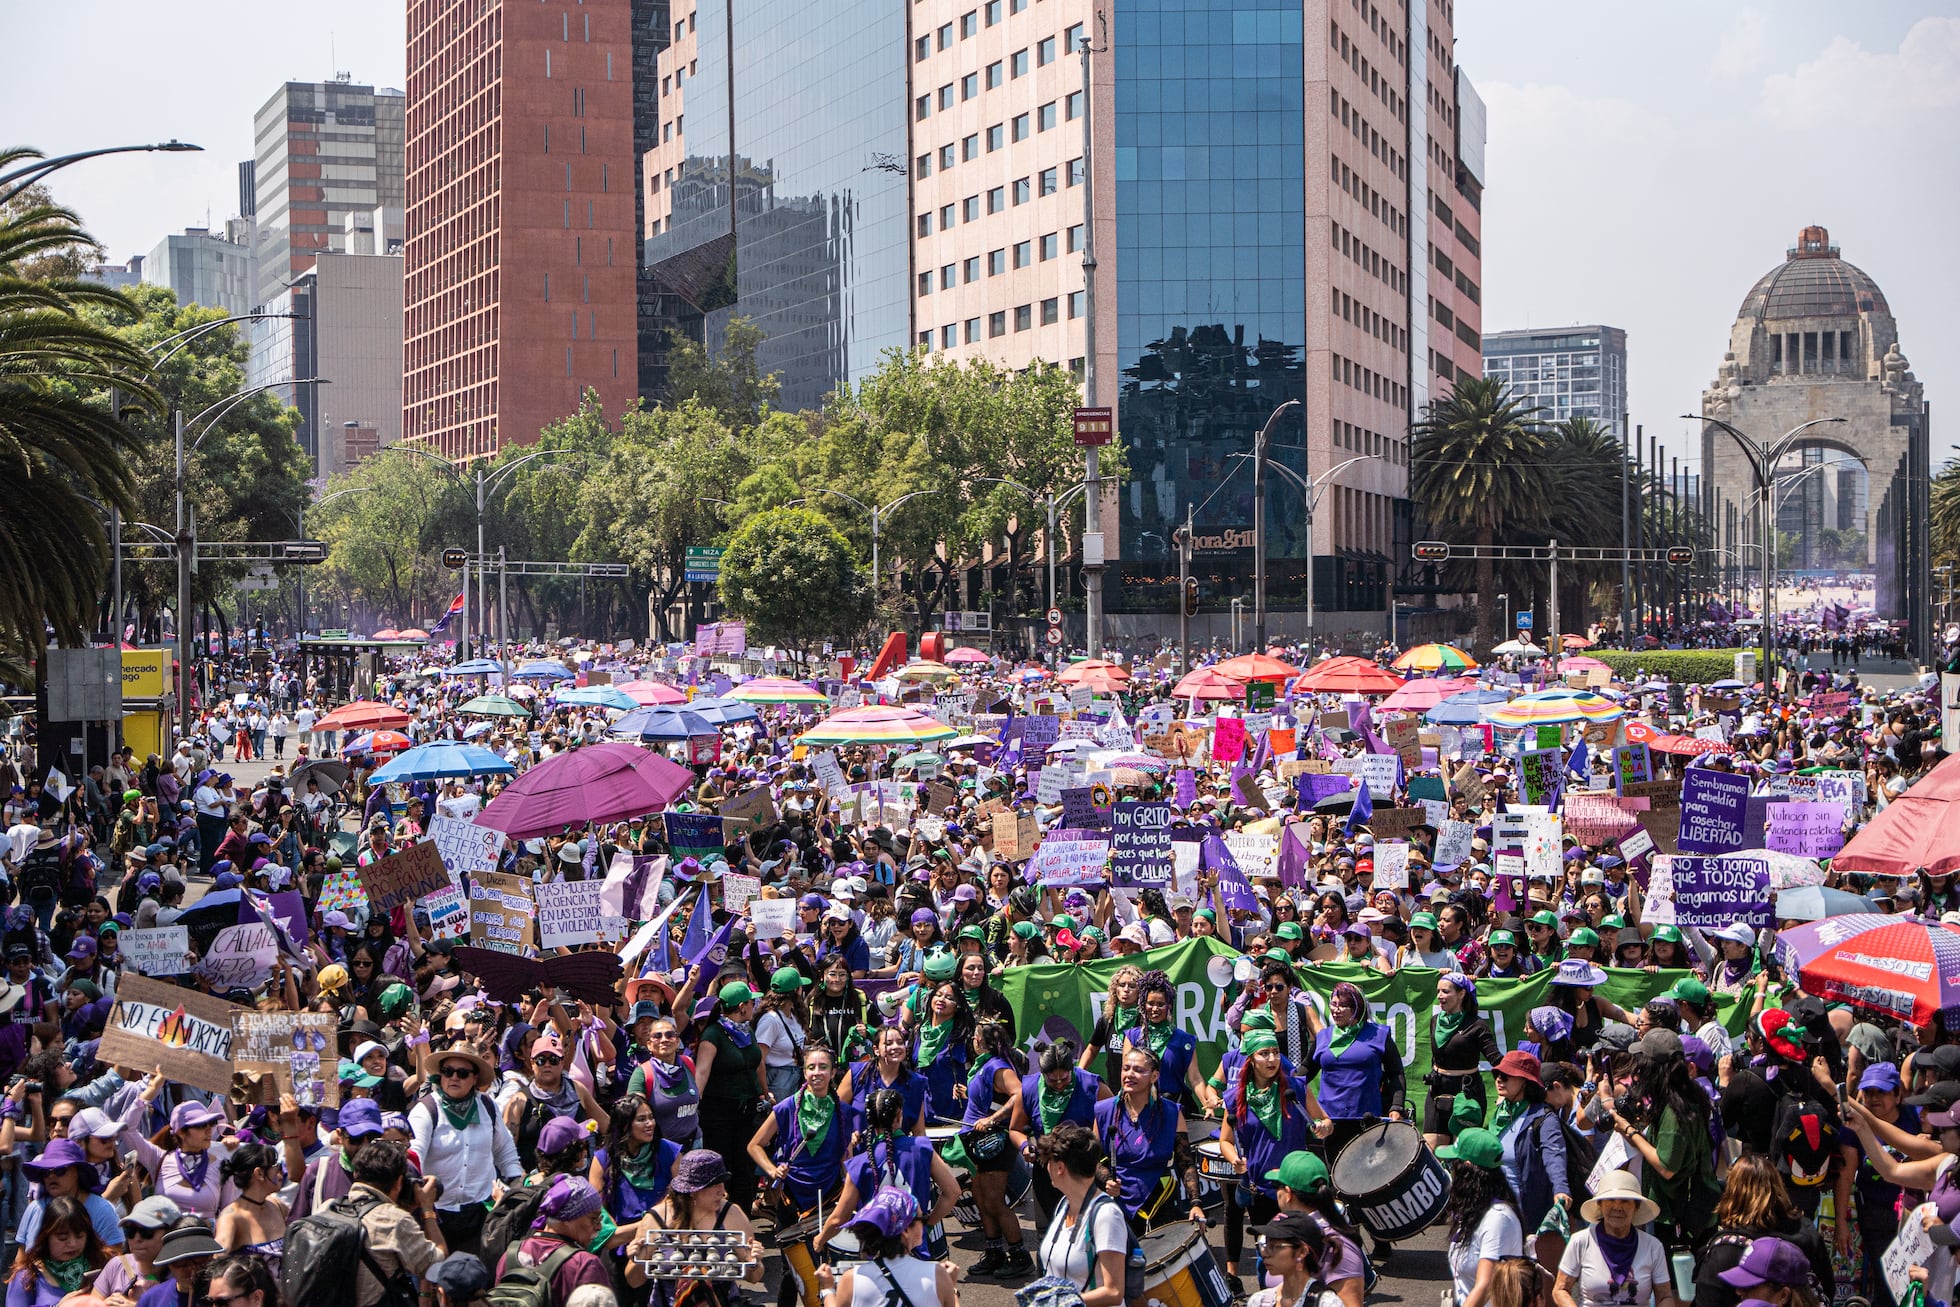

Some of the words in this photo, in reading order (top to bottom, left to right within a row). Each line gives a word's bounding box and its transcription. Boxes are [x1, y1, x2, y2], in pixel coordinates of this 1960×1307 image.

[1172, 528, 1223, 551] Snora
[122, 674, 140, 682] ago
[1620, 752, 1631, 762] NO
[1622, 764, 1643, 773] SOLA
[1691, 773, 1747, 795] Sembramos
[1788, 778, 1816, 787] ABUSO
[1697, 789, 1737, 808] rebeldía
[1112, 807, 1132, 828] hoy
[1133, 806, 1171, 826] GRITO
[1685, 802, 1709, 815] para
[1767, 805, 1809, 822] Nutrición
[1815, 812, 1831, 821] sin
[429, 815, 481, 842] MUERTE
[1690, 815, 1737, 831] cosechar
[1114, 833, 1130, 847] por
[1131, 831, 1157, 845] todas
[1158, 831, 1171, 844] las
[1227, 836, 1255, 848] QUIERO
[1260, 837, 1272, 848] SER
[1681, 824, 1743, 846] LIBERTAD
[1776, 837, 1788, 845] Tu
[436, 832, 485, 858] HETERO
[1080, 841, 1104, 851] LIBRE
[365, 858, 403, 881] Hasta
[407, 845, 432, 864] que
[1115, 849, 1136, 859] eces
[1138, 849, 1155, 863] que
[1155, 848, 1172, 860] tuv
[1114, 865, 1132, 878] que
[1132, 863, 1172, 881] CALLAR
[1672, 858, 1692, 871] NO
[1702, 858, 1720, 871] es
[1722, 859, 1769, 875] normal
[368, 880, 391, 897] no
[396, 862, 435, 890] falte
[1672, 871, 1697, 888] que
[1701, 870, 1756, 889] TODAS
[373, 871, 448, 914] NINGUNA
[472, 887, 484, 899] NO
[539, 897, 551, 909] LA
[552, 895, 587, 908] CIENCIA
[588, 893, 601, 904] ME
[1676, 889, 1738, 908] tengamos
[542, 910, 556, 921] EN
[557, 908, 571, 920] LAS
[1673, 910, 1713, 925] historia
[1713, 911, 1732, 929] que
[1732, 909, 1770, 925] contar
[543, 923, 557, 935] DE
[557, 919, 602, 933] VIOLENCIA
[110, 1000, 144, 1029] NO
[146, 1007, 168, 1040] ES
[171, 1013, 233, 1062] NORMAL
